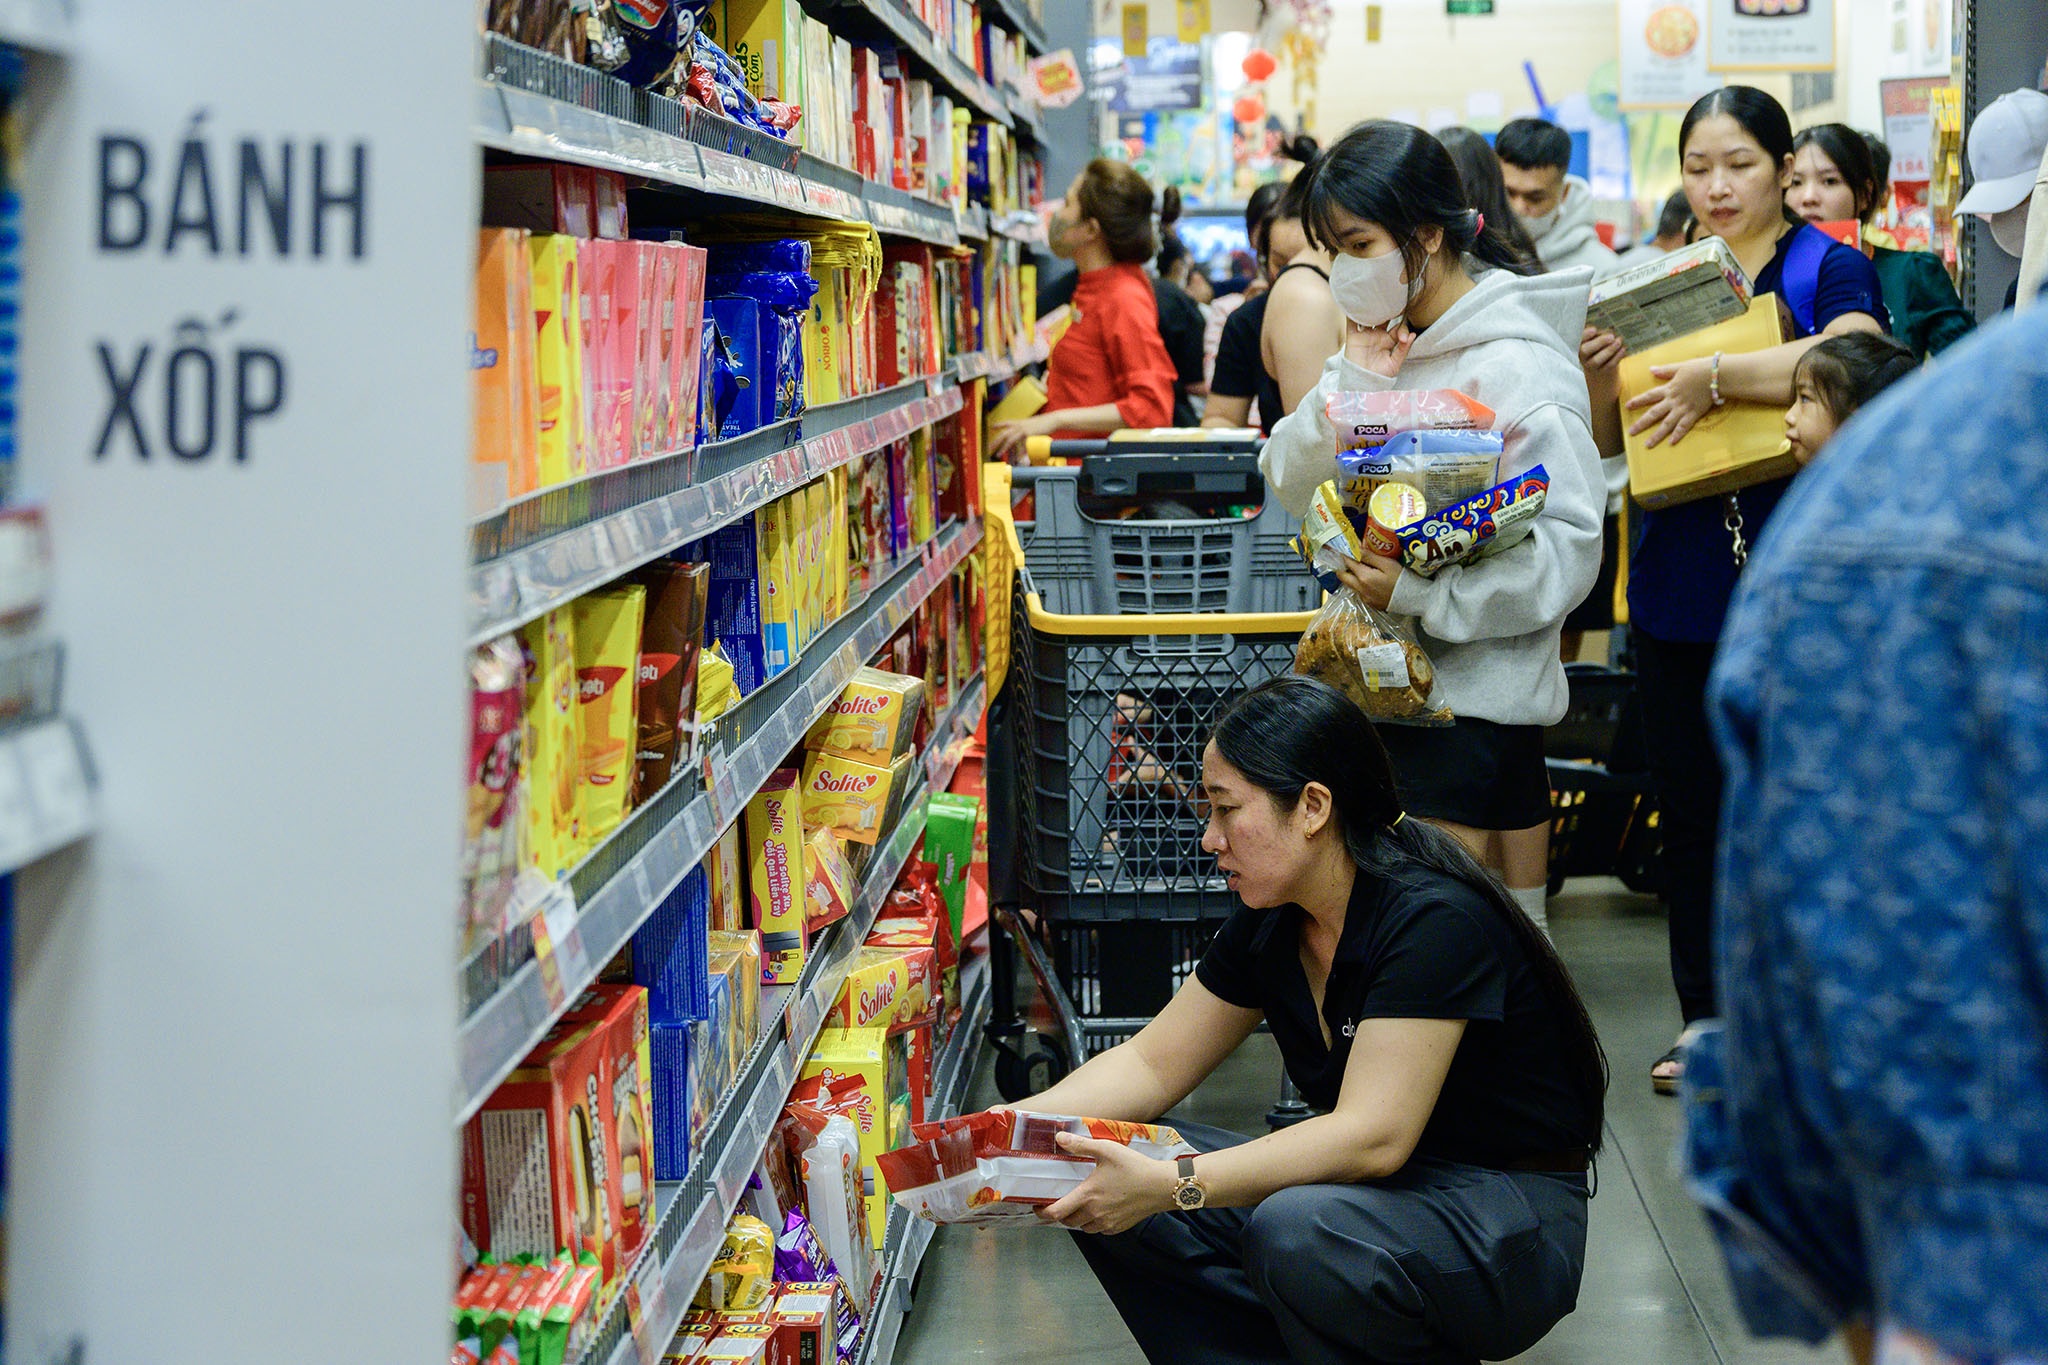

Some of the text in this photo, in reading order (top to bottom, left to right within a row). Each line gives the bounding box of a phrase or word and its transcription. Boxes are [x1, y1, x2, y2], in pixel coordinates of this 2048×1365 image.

[95, 107, 369, 261] BÁNH
[822, 337, 831, 371] ORION
[95, 308, 286, 463] XỐP
[1357, 426, 1386, 436] POCA
[1361, 465, 1390, 475] POCA
[826, 693, 879, 715] Solite
[812, 769, 867, 793] Solite
[765, 798, 784, 834] Solite
[857, 981, 894, 1026] Solite
[855, 1095, 873, 1134] Solite
[789, 1281, 830, 1291] RITZ
[729, 1324, 771, 1334] RITZ
